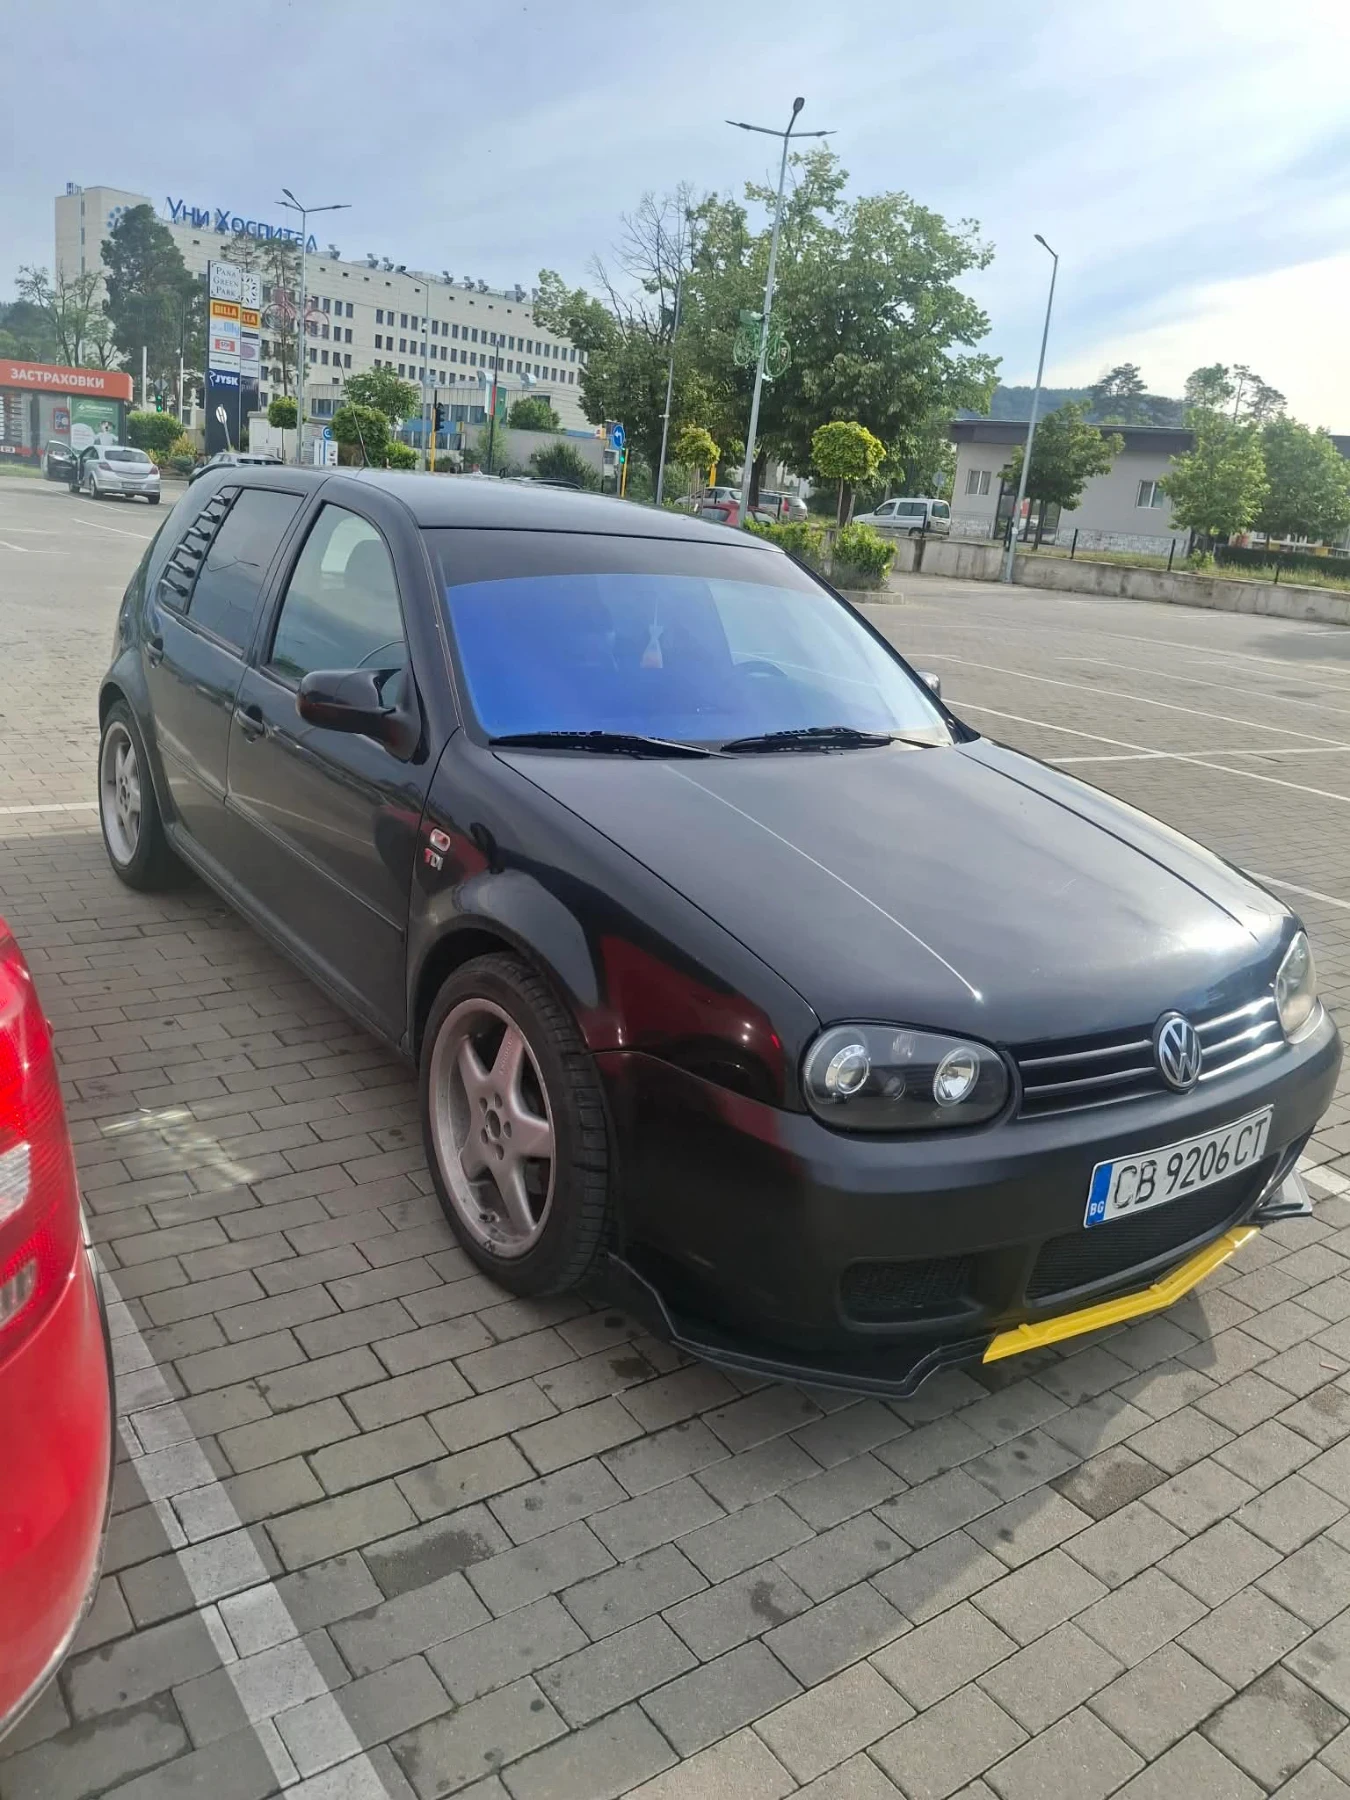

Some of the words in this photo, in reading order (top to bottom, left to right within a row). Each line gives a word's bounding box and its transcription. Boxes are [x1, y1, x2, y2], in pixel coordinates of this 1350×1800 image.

[166, 196, 210, 227] Уни
[214, 304, 238, 318] BILLA
[10, 367, 105, 389] ЗАСТРАХОВКИ
[215, 374, 239, 386] JYSK
[1166, 1134, 1232, 1195] 9206
[1089, 1200, 1105, 1216] BG
